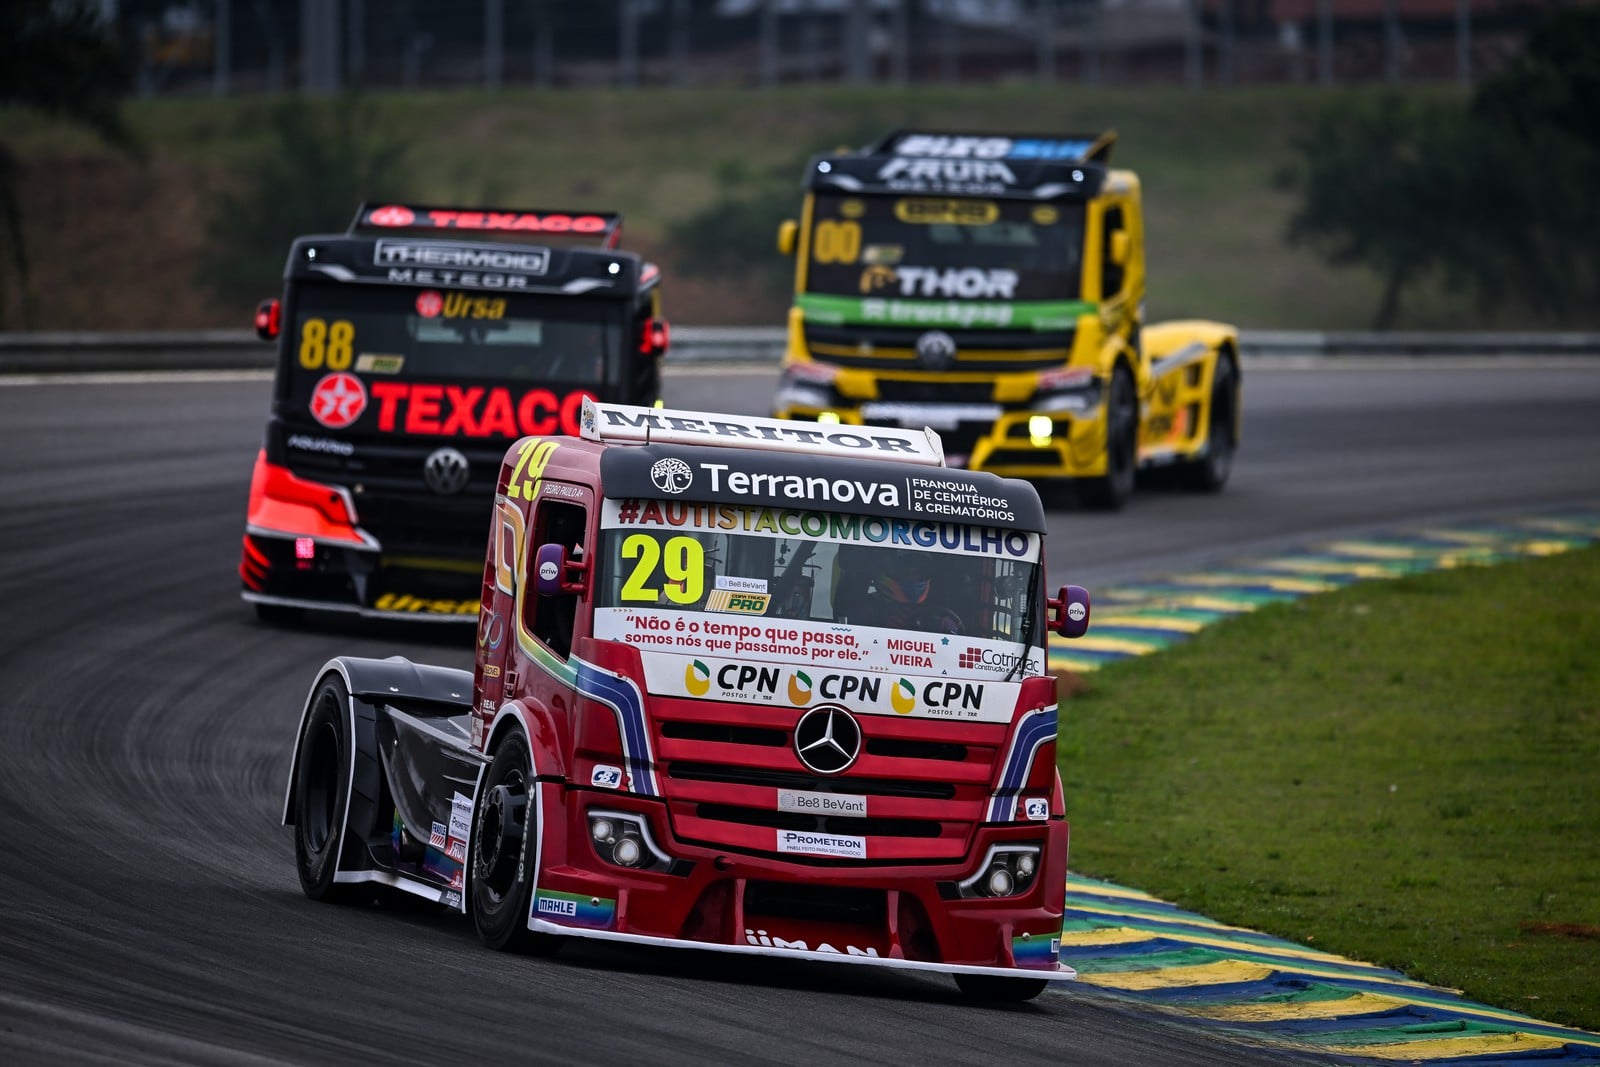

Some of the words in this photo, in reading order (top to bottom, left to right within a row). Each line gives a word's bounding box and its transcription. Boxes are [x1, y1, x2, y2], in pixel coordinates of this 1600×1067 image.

[428, 210, 606, 233] TEXACO
[381, 245, 542, 272] THERMOID
[388, 267, 529, 288] METEOR
[896, 266, 1019, 299] THOR
[443, 292, 507, 320] Ursa
[301, 317, 355, 371] 88
[371, 381, 596, 438] TEXACO
[601, 409, 920, 453] MERITOR
[507, 437, 561, 502] 29
[543, 483, 561, 495] PEDRO
[559, 486, 577, 497] PAULO
[700, 462, 900, 507] Terranova
[912, 478, 978, 494] FRANQUIA
[913, 489, 932, 500] DE
[934, 491, 1009, 509] CEMITÉRIOS
[914, 502, 923, 512] &
[926, 502, 1015, 522] CREMATÓRIOS
[618, 499, 1030, 557] #AUTISTACOMORGULHO
[620, 533, 705, 605] 29
[728, 599, 765, 611] PRO
[675, 615, 686, 632] é
[689, 622, 700, 633] o
[704, 620, 762, 641] tempo
[764, 627, 800, 644] que
[802, 631, 860, 649] passa,
[624, 632, 673, 645] somos
[676, 633, 701, 647] nós
[705, 639, 732, 651] que
[735, 640, 808, 656] passamos
[811, 647, 834, 660] por
[887, 638, 937, 654] MIGUEL
[889, 653, 933, 669] VIEIRA
[974, 663, 1006, 673] Construção
[717, 663, 780, 694] CPN
[819, 674, 882, 703] CPN
[721, 691, 748, 699] POSTOS
[923, 681, 984, 710] CPN
[927, 708, 953, 716] POSTOS
[797, 796, 821, 809] Be8
[822, 798, 864, 812] BeVant
[784, 832, 861, 848] PROMETEON
[539, 899, 574, 914] MAHLE
